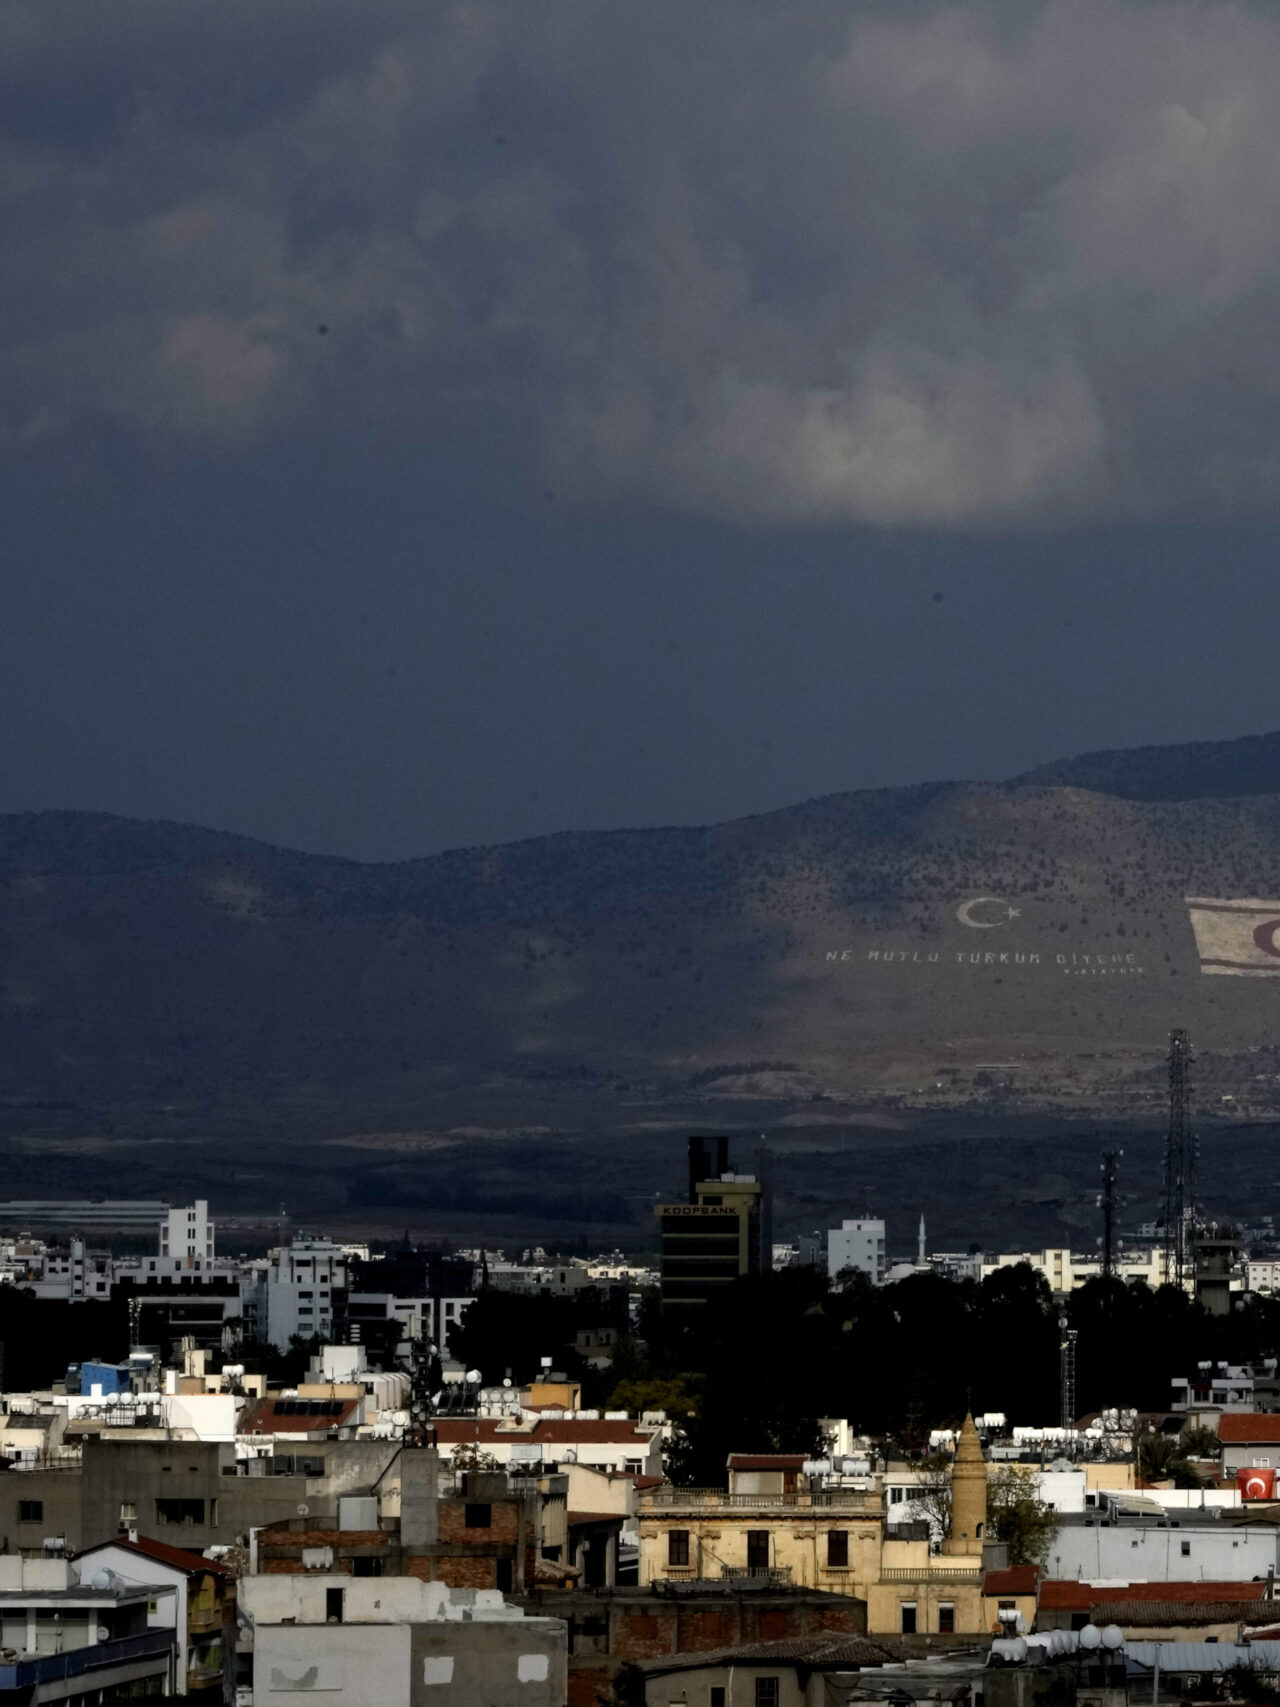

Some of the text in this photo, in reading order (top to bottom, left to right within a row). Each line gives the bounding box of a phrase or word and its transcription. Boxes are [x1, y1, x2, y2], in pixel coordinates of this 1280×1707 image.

[826, 950, 852, 961] NE
[868, 951, 939, 963] MUTLU
[663, 1207, 737, 1215] KOOPBANK
